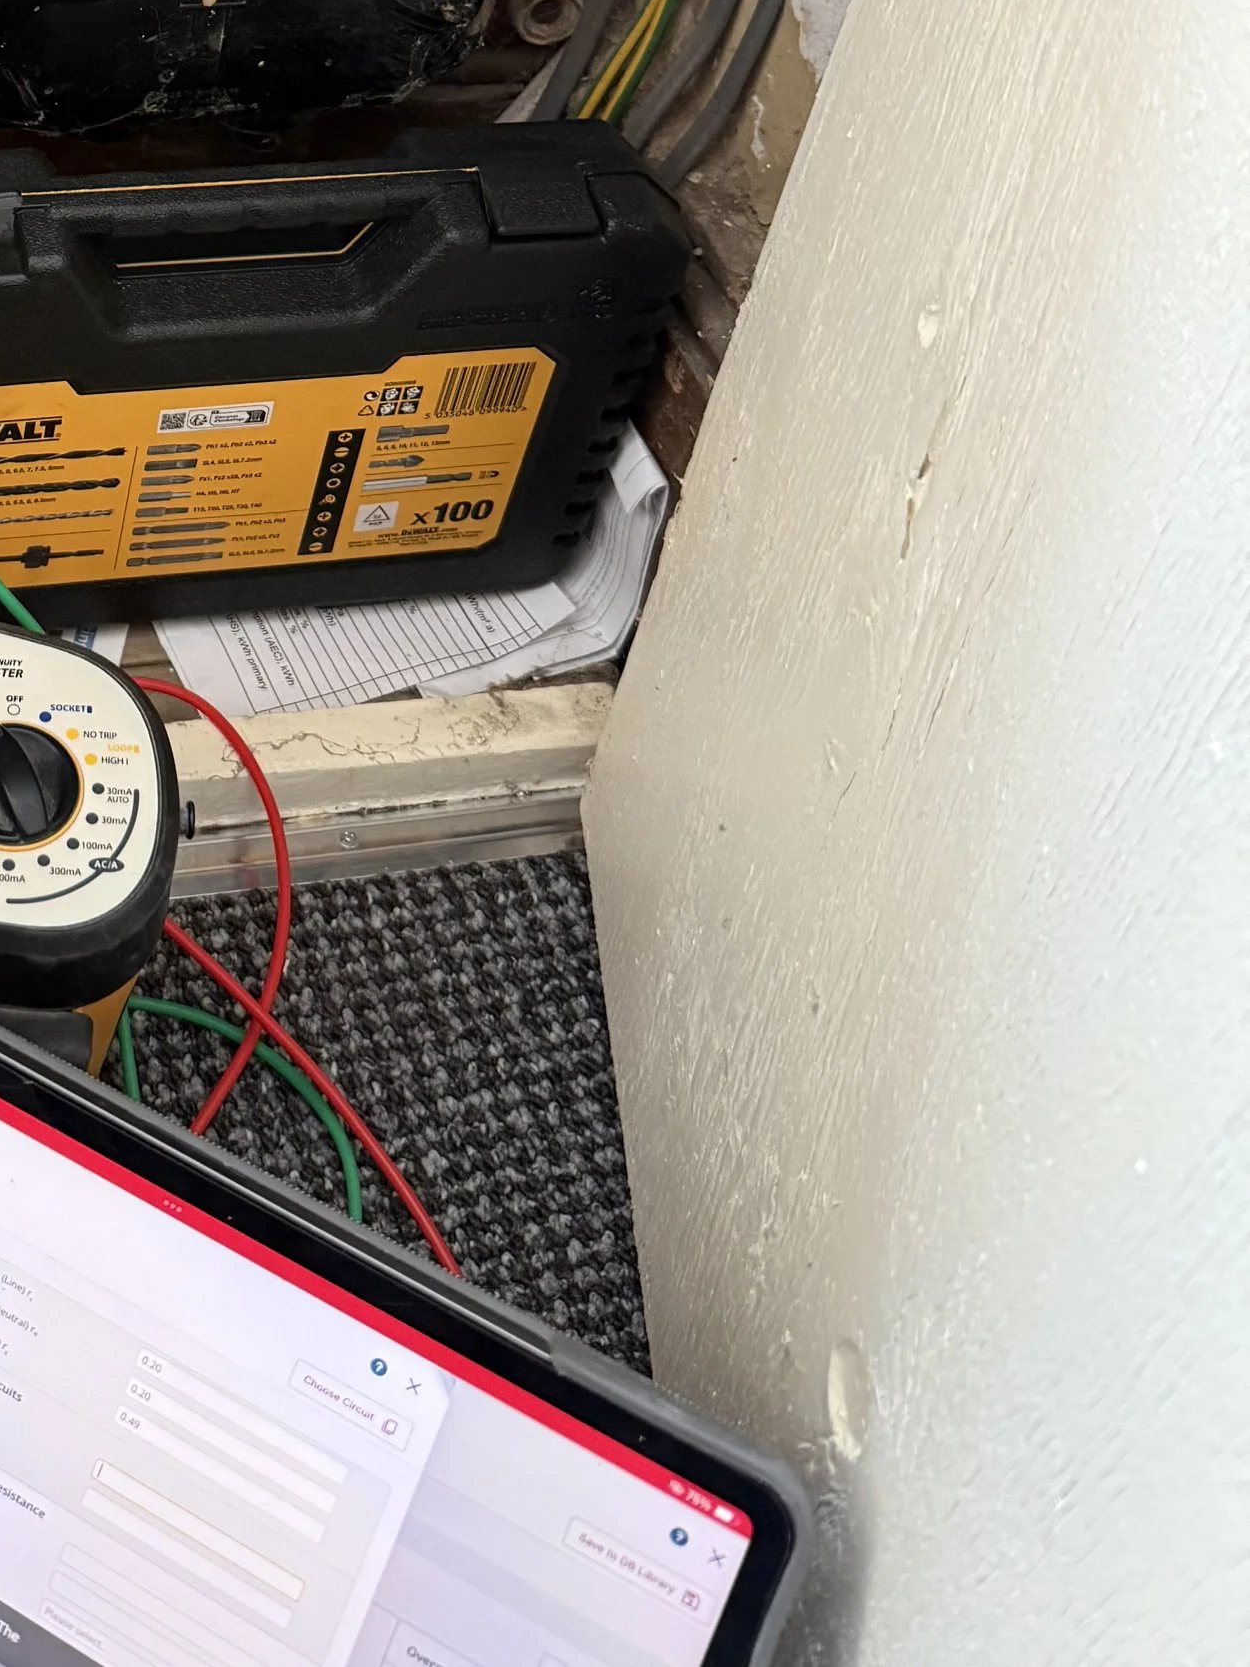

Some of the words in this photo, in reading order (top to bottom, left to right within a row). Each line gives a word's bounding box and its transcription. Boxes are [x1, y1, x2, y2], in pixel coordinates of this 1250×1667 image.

[435, 409, 475, 419] 035048
[479, 405, 519, 416] 099940
[410, 498, 495, 526] x100
[237, 636, 251, 657] kWh
[250, 657, 269, 690] primary
[280, 665, 296, 687] kWh
[5, 694, 25, 703] OFF
[49, 703, 87, 714] SOCKET
[106, 786, 133, 796] 30mA
[101, 815, 128, 825] 30mA
[81, 840, 114, 851] 100mA
[49, 865, 82, 877] 300mA
[303, 1375, 341, 1402] Choose
[341, 1396, 376, 1422] Circuit
